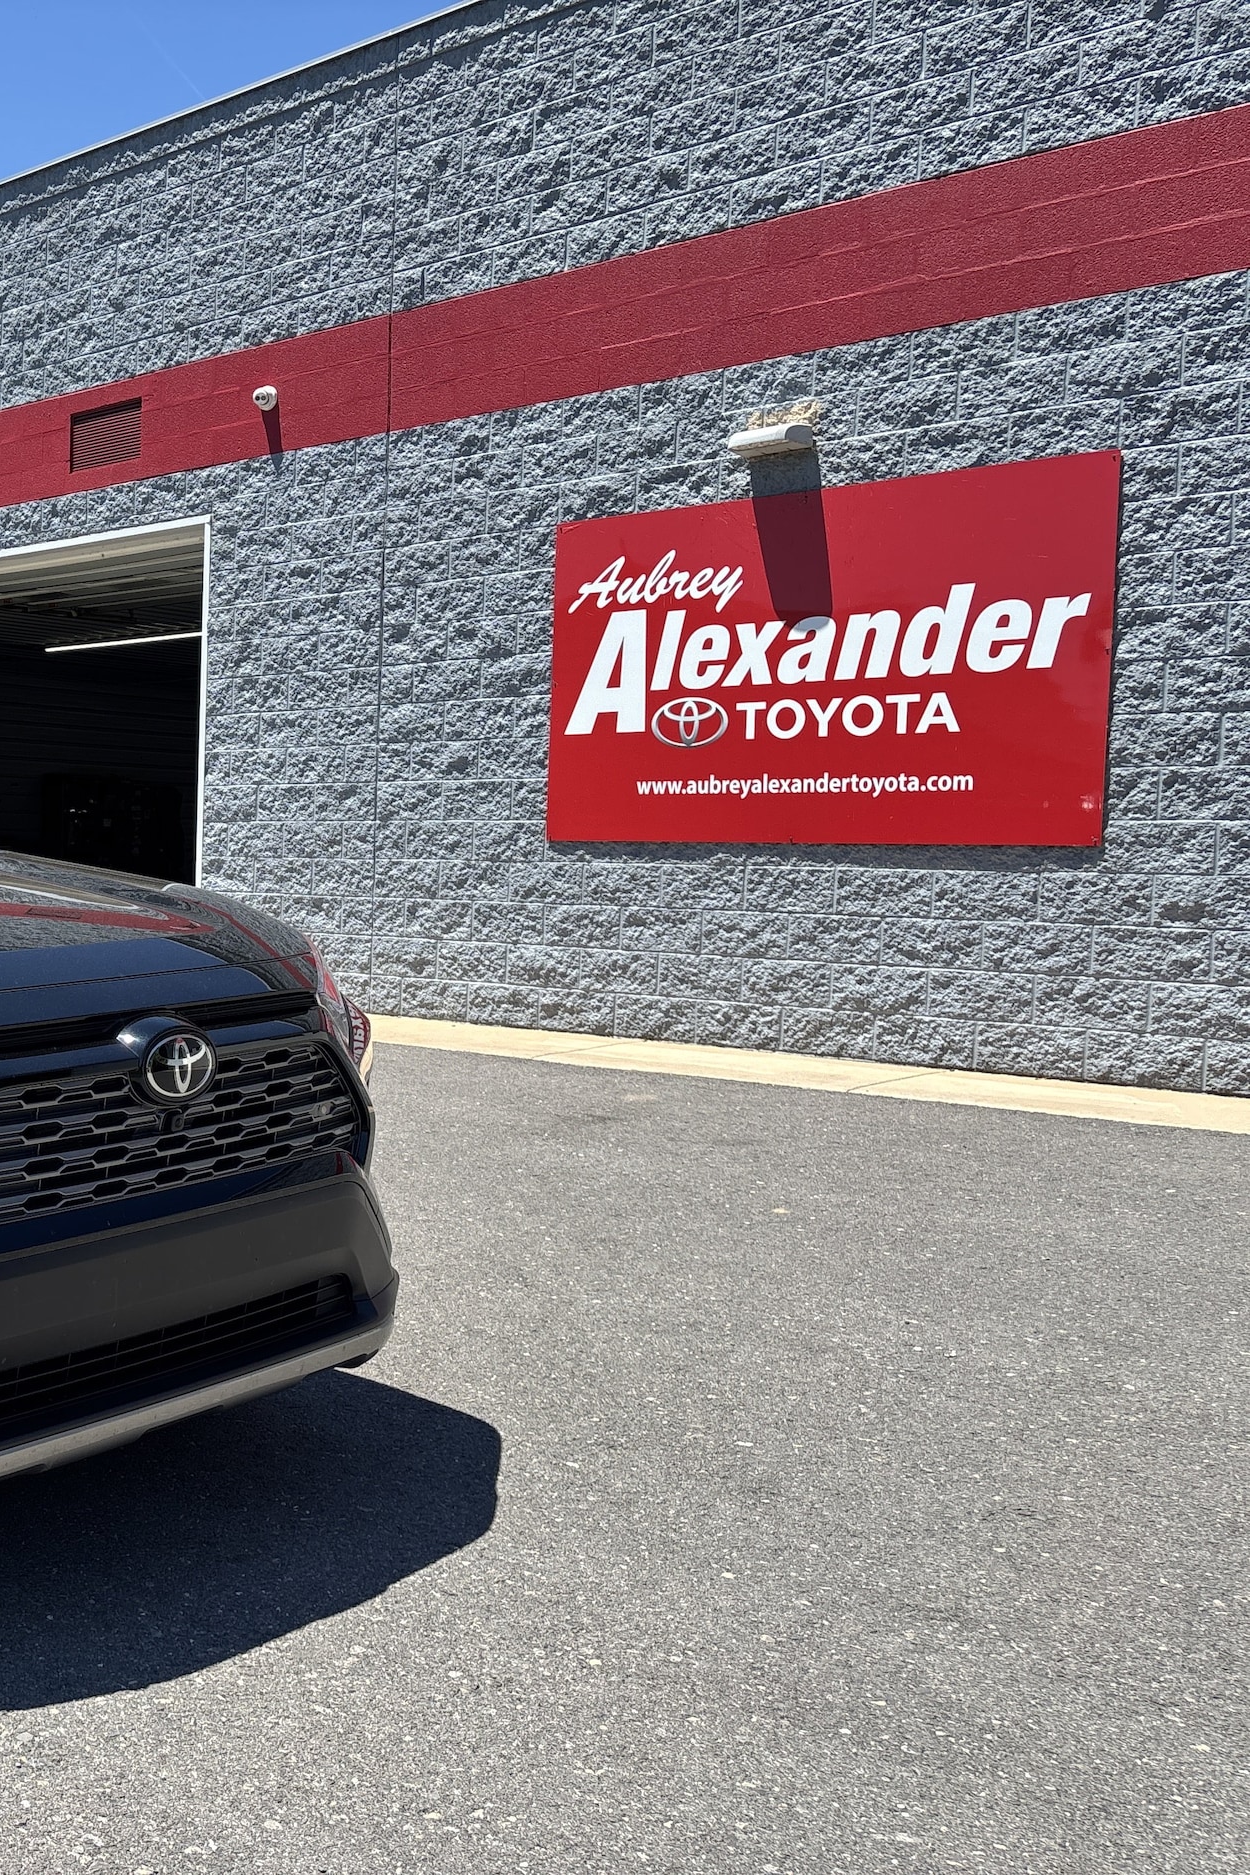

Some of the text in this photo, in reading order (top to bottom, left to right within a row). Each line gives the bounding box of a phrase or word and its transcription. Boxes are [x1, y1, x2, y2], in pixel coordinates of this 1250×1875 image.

[567, 549, 744, 614] Aubrey
[563, 582, 1092, 736] Alexander
[735, 691, 961, 740] TOYOTA
[636, 771, 974, 800] www.aubreyalexandertoyota.com
